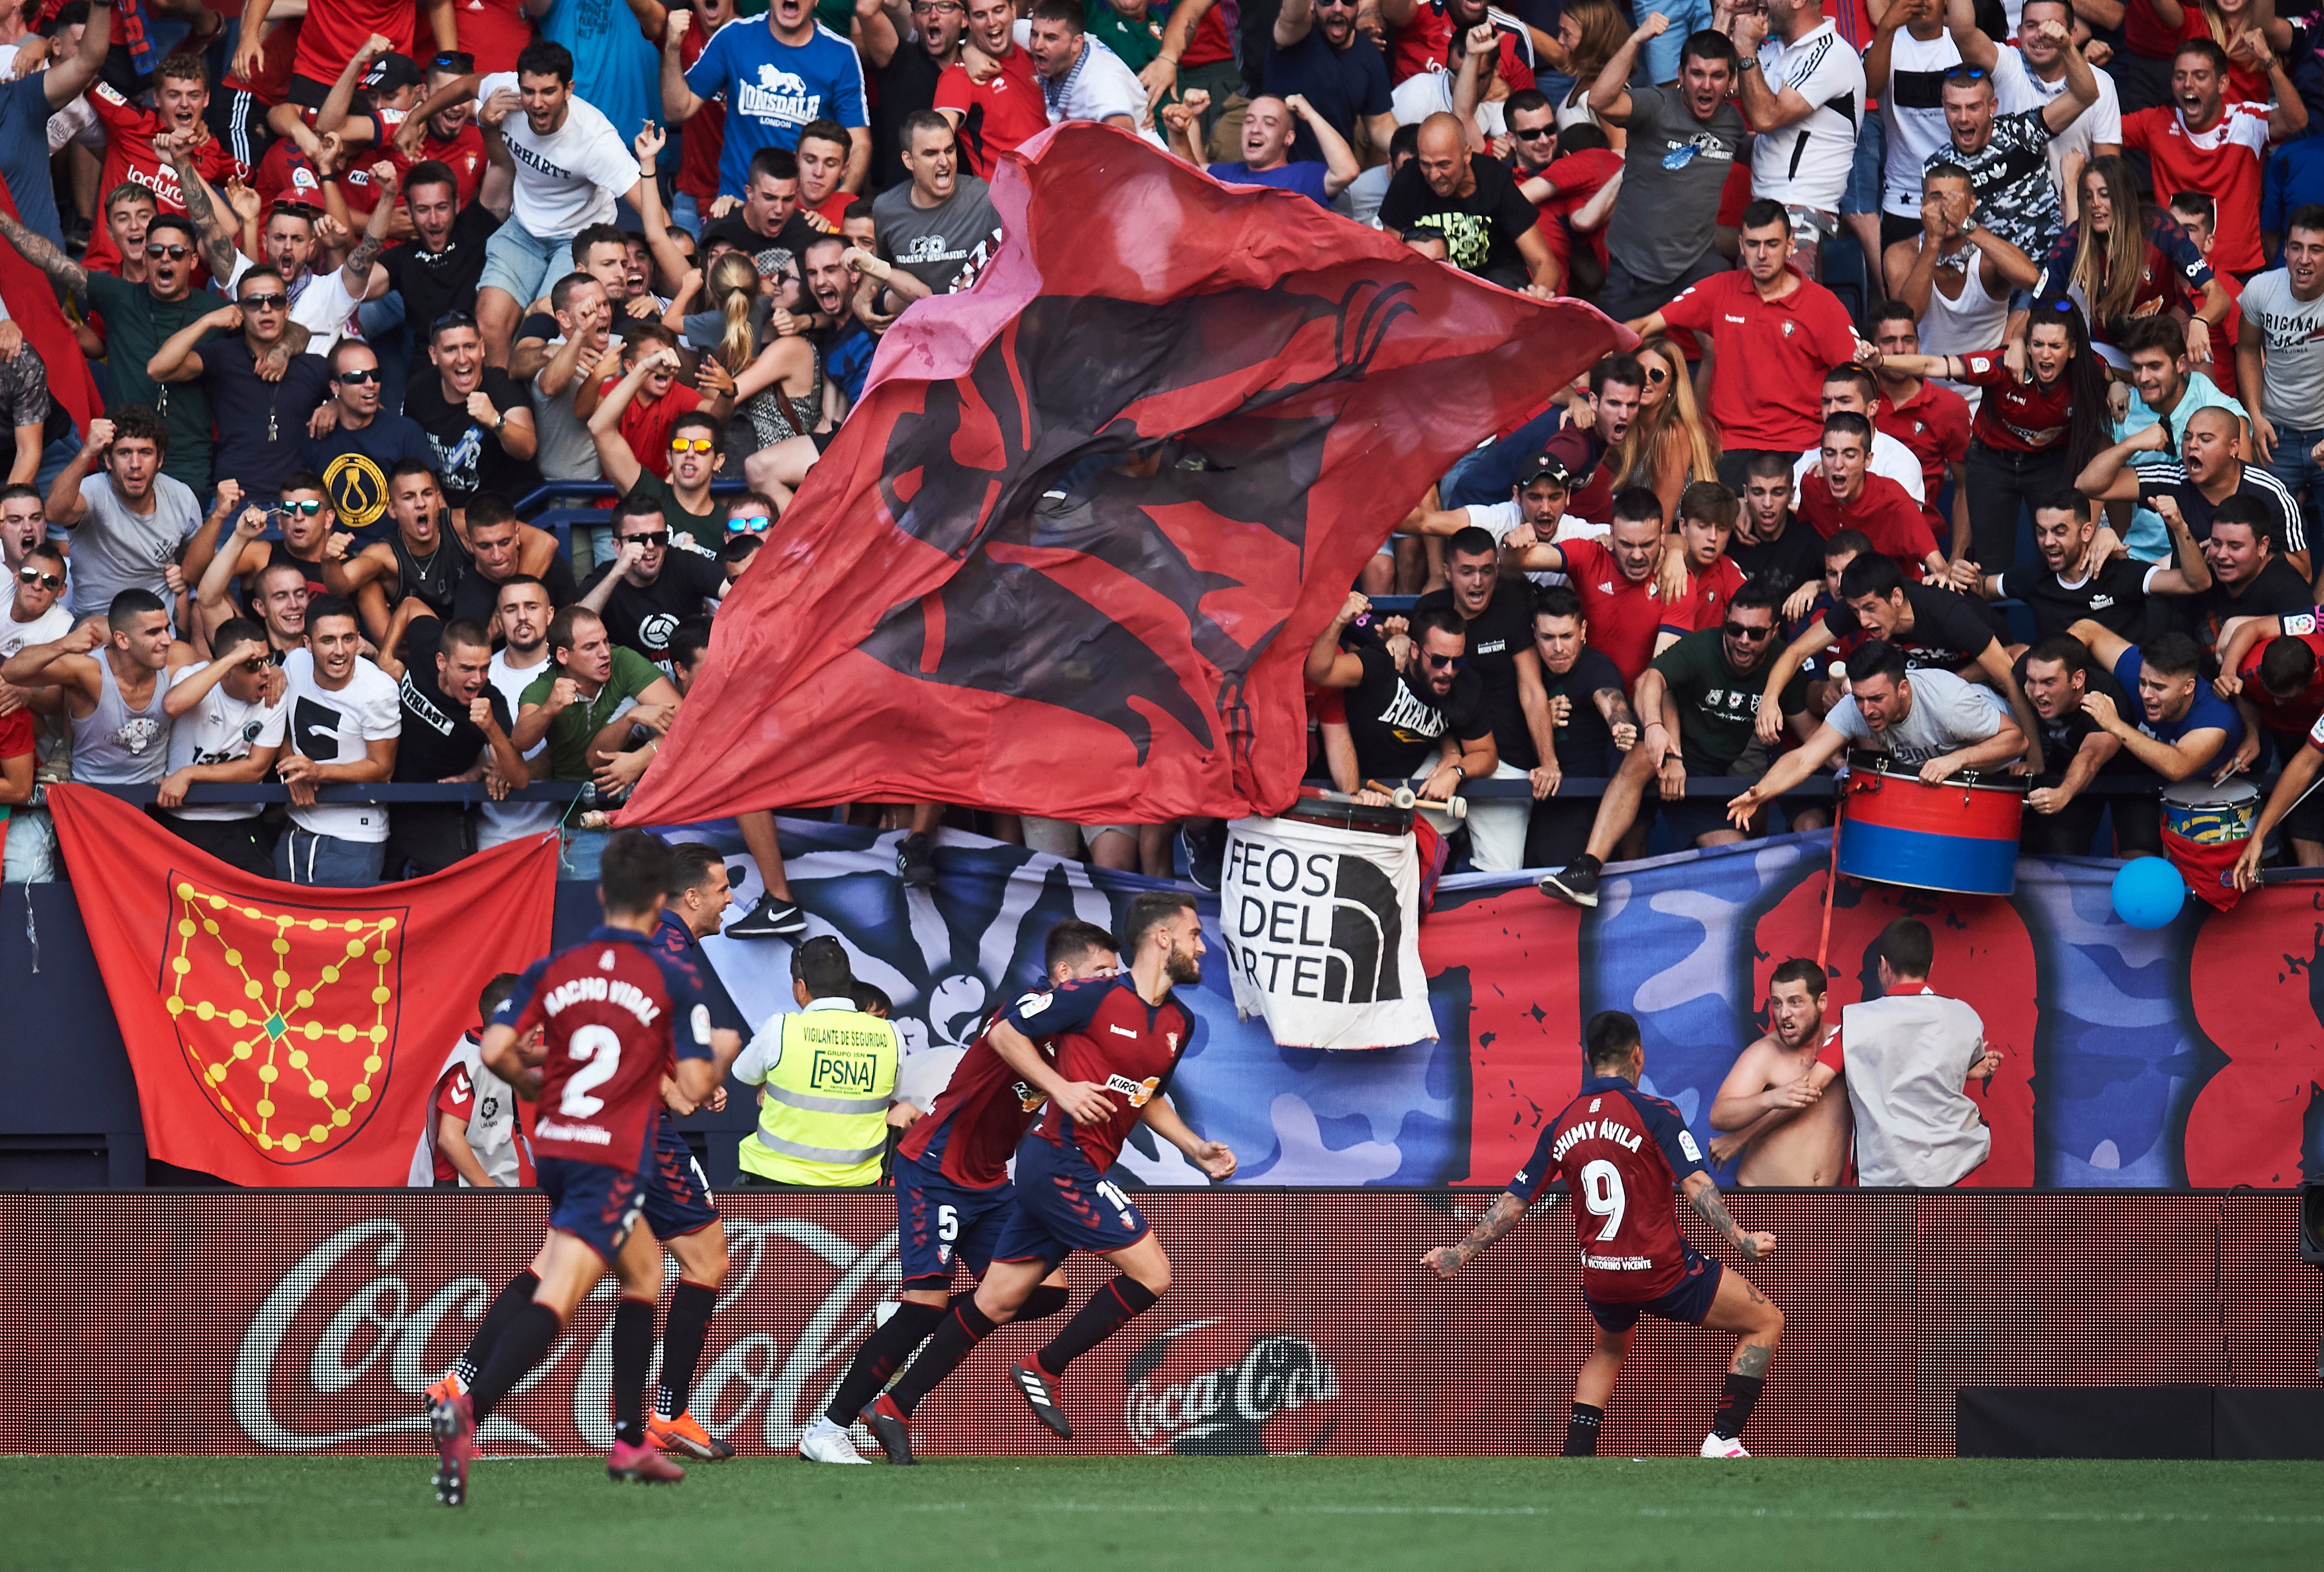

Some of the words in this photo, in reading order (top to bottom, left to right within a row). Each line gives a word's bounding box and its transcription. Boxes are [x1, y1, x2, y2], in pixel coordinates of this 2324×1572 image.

[739, 78, 821, 124] LONSDALE
[759, 116, 792, 129] LONDON
[501, 131, 571, 179] CARHARTT
[127, 164, 183, 203] lactura
[403, 678, 449, 729] EVERLAST
[1378, 677, 1449, 739] EVERLAS
[1228, 839, 1333, 897] FEOS
[1239, 896, 1324, 947] DEL
[544, 977, 608, 1018] NACHO
[608, 979, 661, 1028] VIDAL
[804, 1027, 838, 1045] VIGILANTE
[840, 1030, 850, 1045] DE
[851, 1031, 888, 1048] SEGURIDAD
[827, 1050, 852, 1058] GRUPO
[1110, 1024, 1137, 1039] hummel
[559, 1024, 621, 1119] 2
[1552, 1121, 1596, 1162] CHIMY
[1599, 1117, 1643, 1154] ÁVILA
[938, 1205, 958, 1241] 5
[1581, 1159, 1626, 1241] 9
[1588, 1259, 1621, 1271] VICTORINO
[1622, 1260, 1652, 1270] VICENTE
